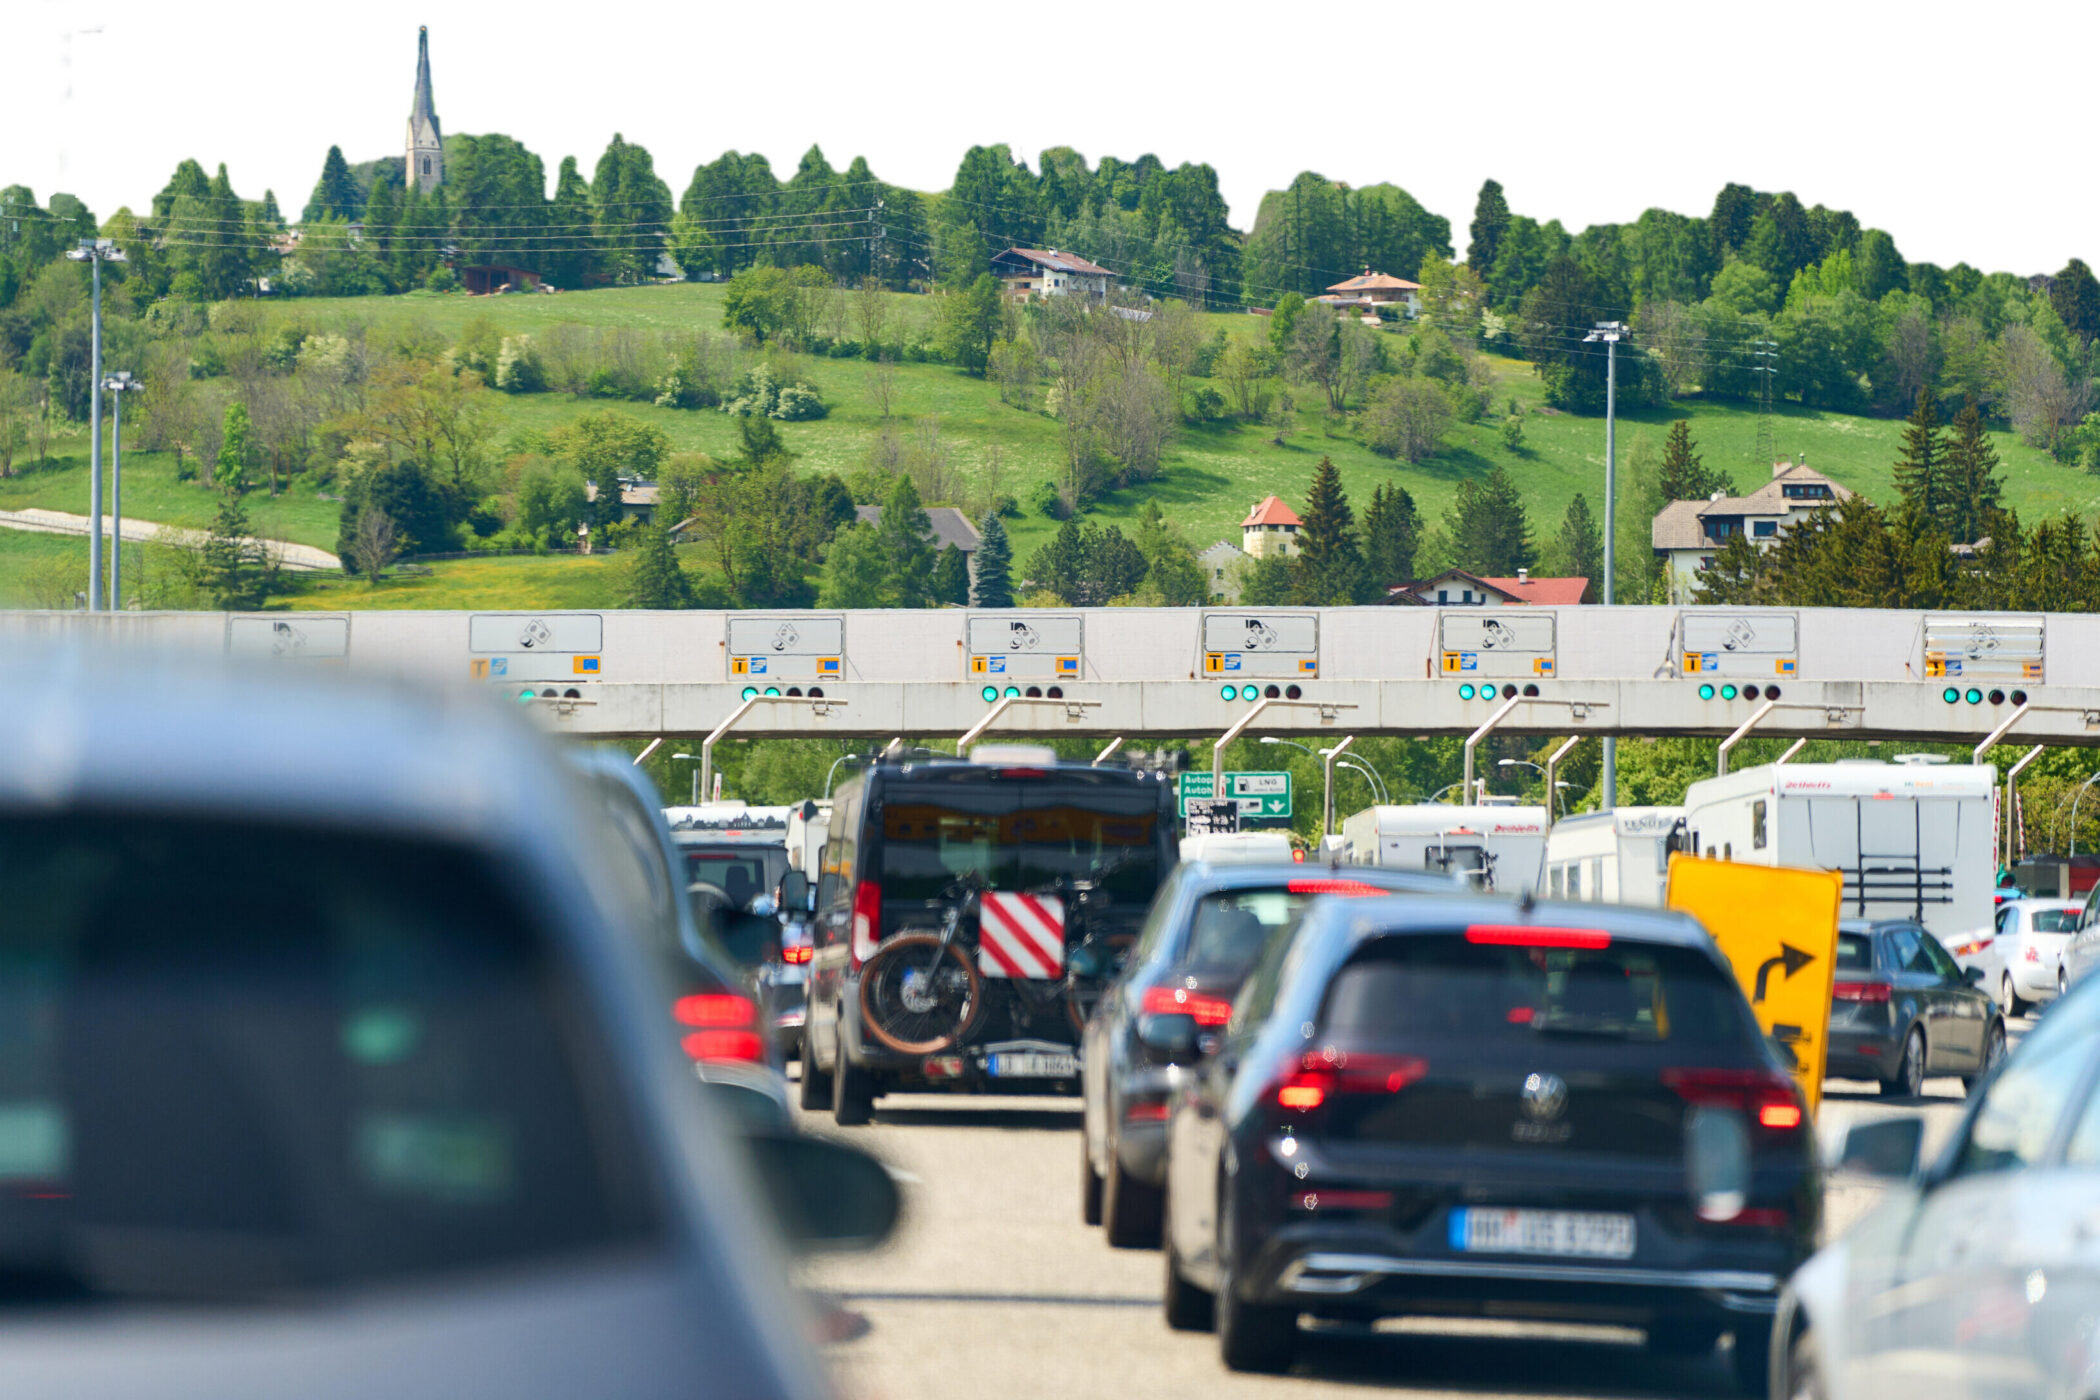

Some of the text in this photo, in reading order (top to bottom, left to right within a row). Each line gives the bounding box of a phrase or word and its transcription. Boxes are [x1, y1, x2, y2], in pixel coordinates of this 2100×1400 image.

[1208, 654, 1222, 670] T
[1445, 653, 1458, 670] T
[1686, 654, 1699, 671] T
[1259, 778, 1278, 786] LNG
